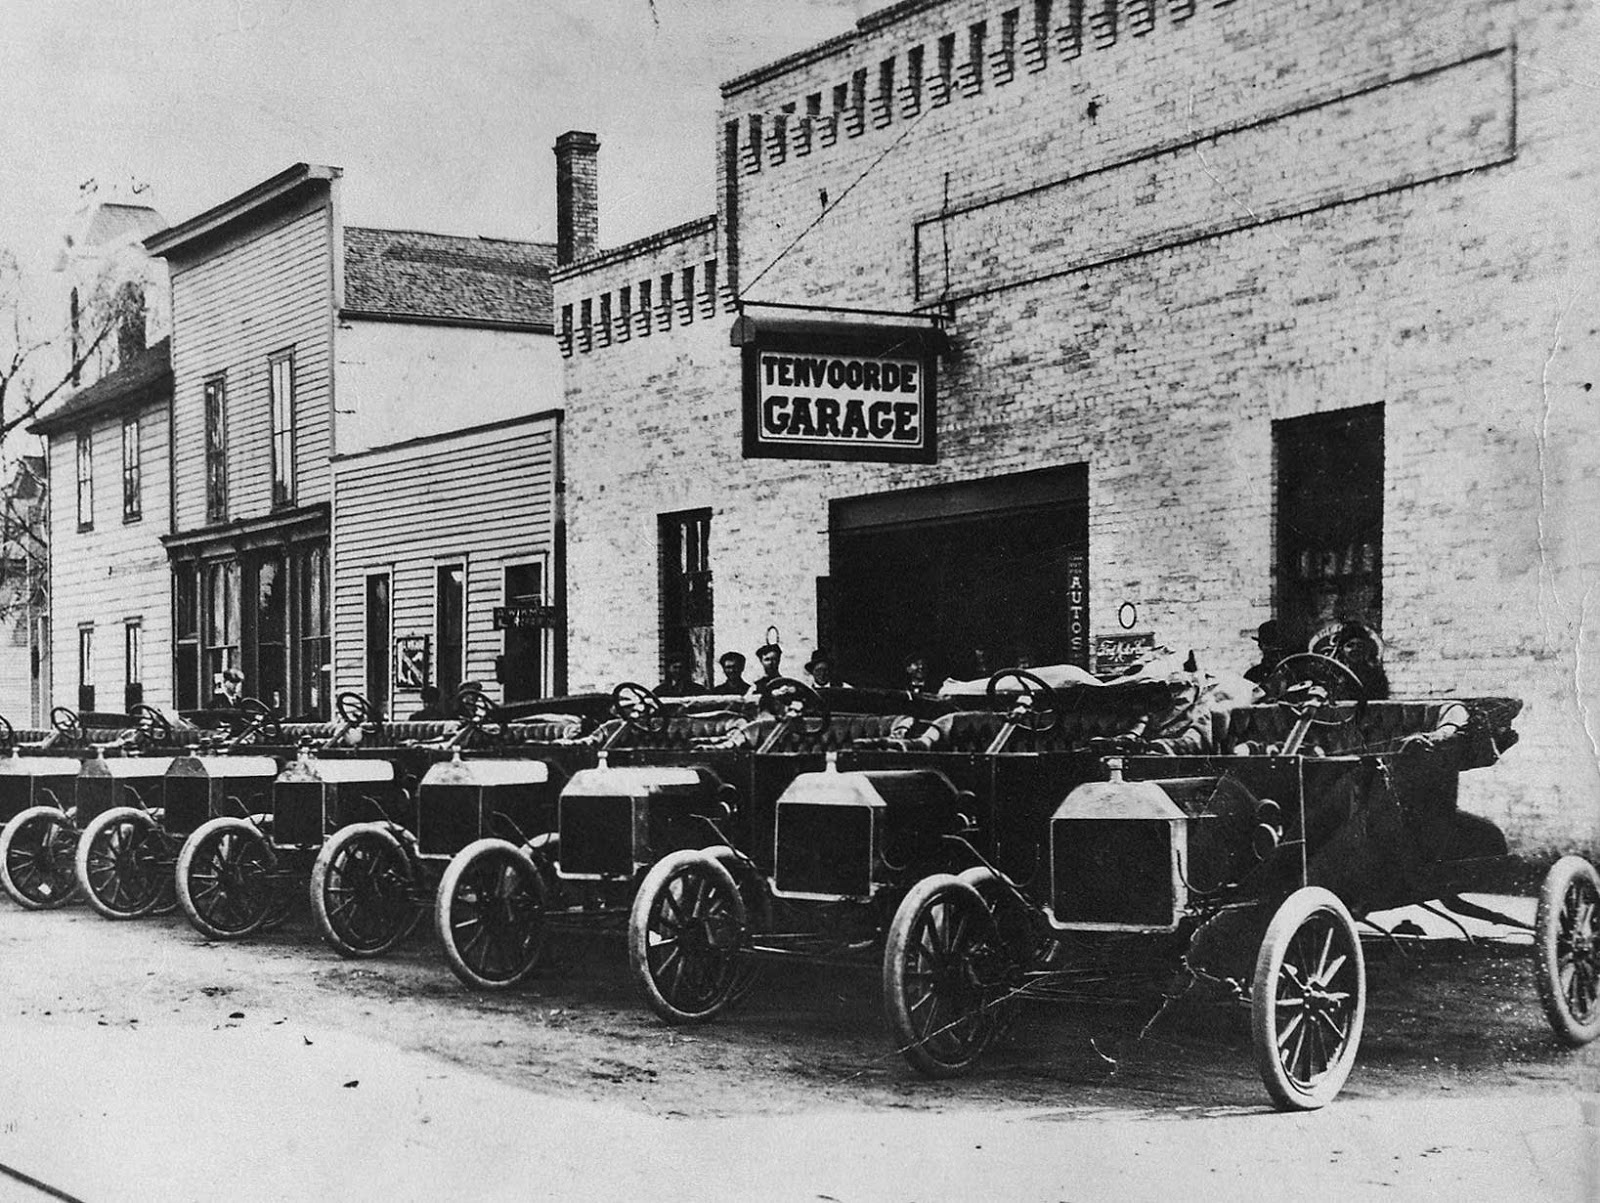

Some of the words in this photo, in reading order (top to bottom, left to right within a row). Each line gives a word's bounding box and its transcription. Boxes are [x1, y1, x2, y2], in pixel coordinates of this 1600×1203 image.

[762, 356, 917, 393] TENVOORDE
[763, 395, 918, 440] GARAGE
[1070, 576, 1083, 651] AUTOS
